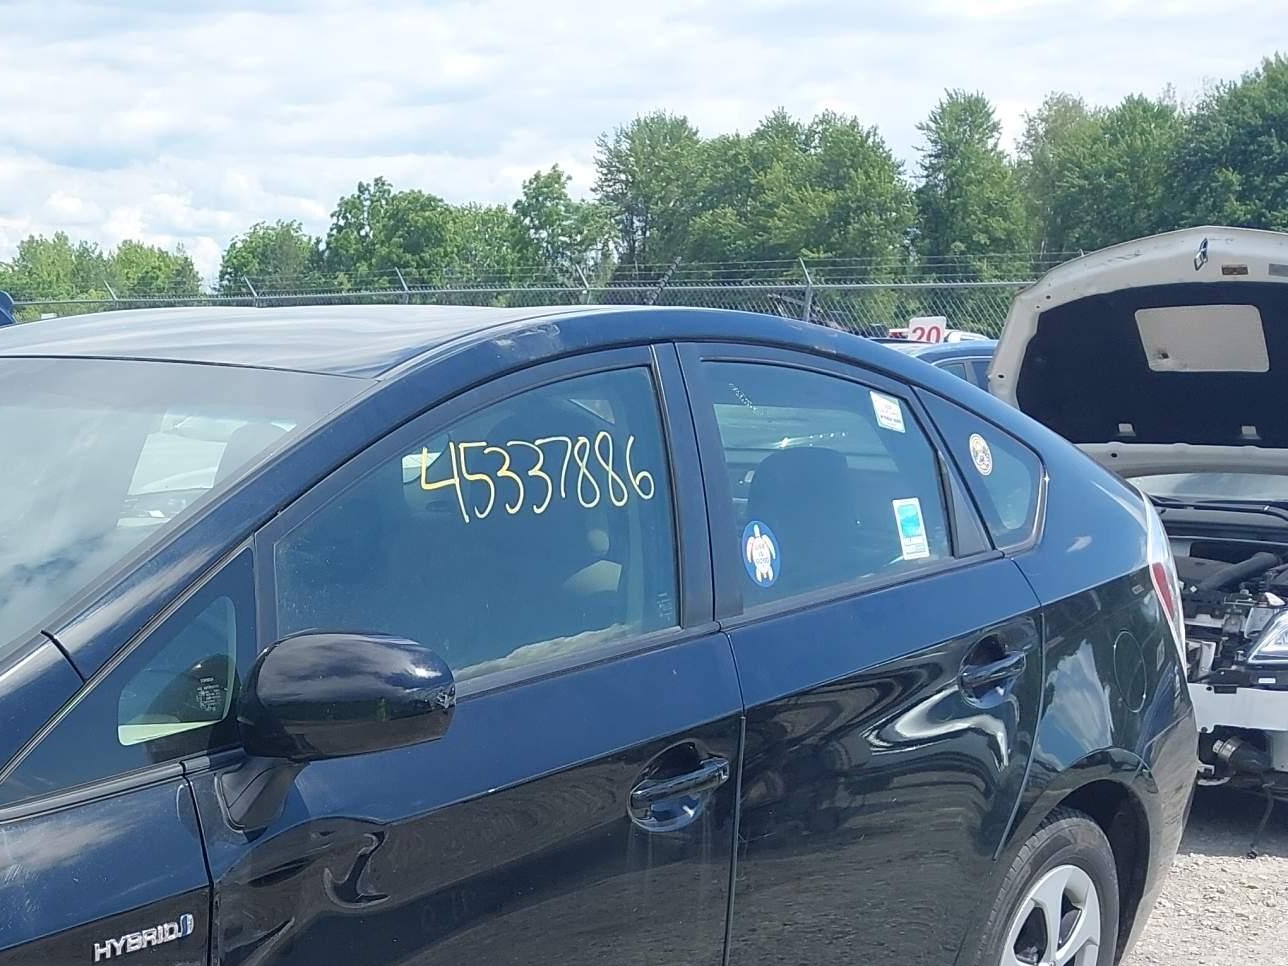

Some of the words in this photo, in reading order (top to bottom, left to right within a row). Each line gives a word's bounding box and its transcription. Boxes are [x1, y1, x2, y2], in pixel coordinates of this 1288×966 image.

[911, 325, 941, 344] 20
[420, 431, 655, 523] 45337886
[93, 921, 179, 962] HYBRID
